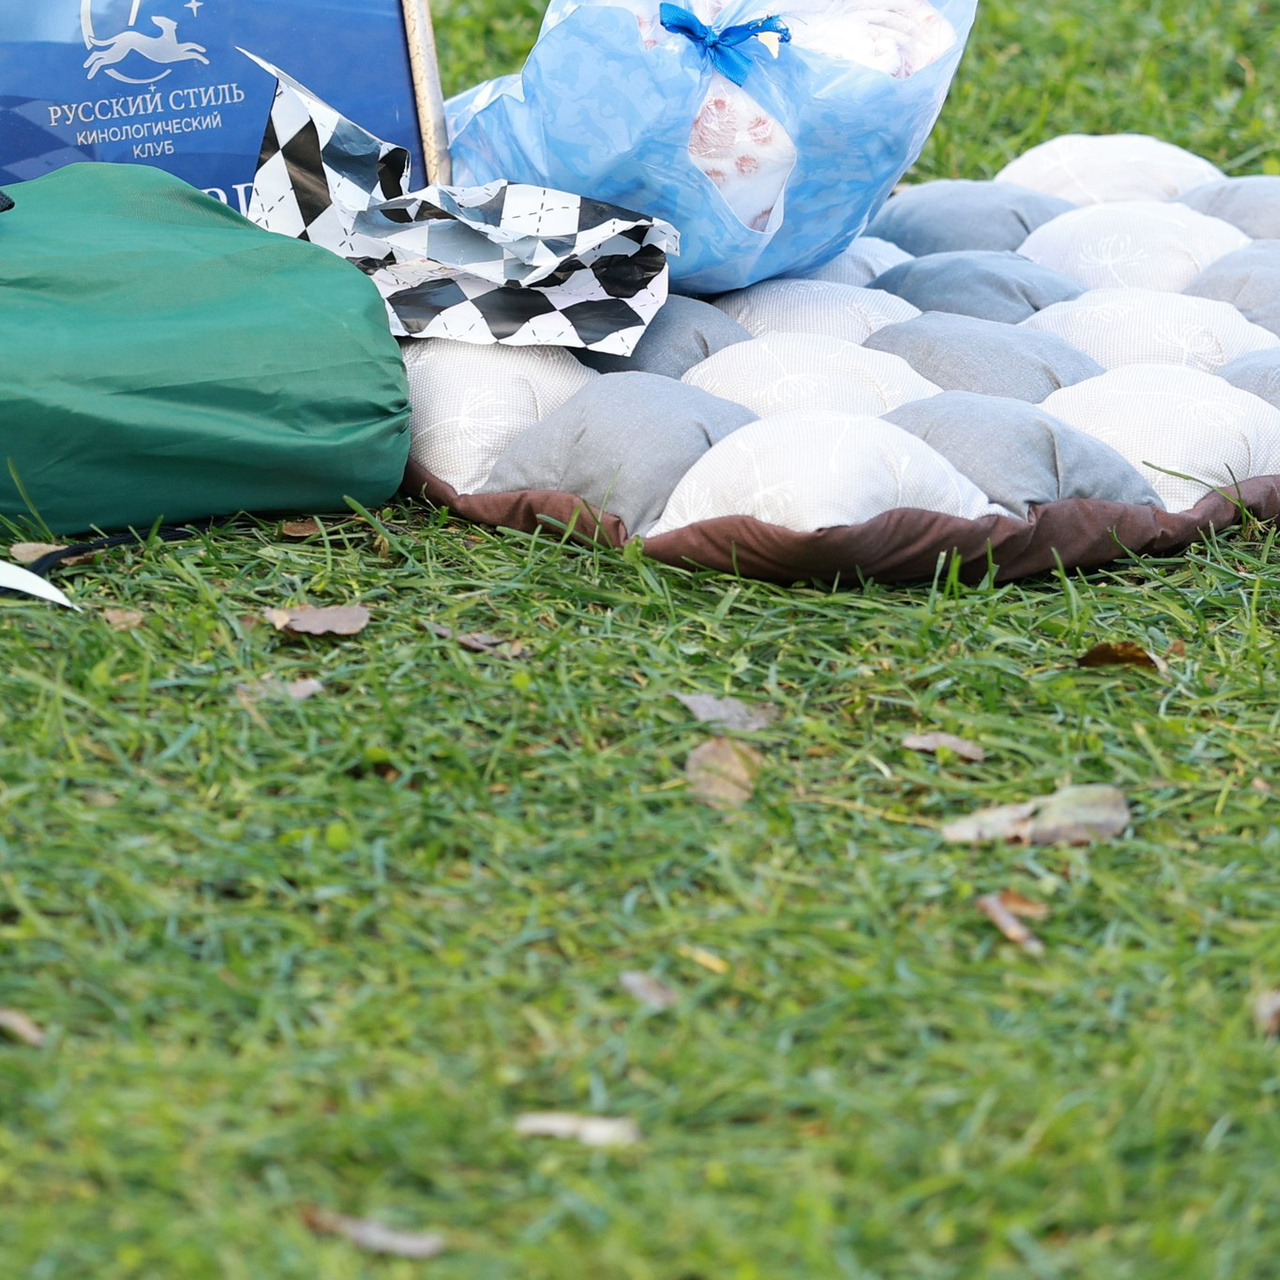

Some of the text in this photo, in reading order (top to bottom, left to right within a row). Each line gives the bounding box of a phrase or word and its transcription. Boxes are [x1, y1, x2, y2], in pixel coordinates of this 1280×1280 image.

[48, 82, 246, 126] РУССКИЙ СТИЛЬ
[76, 113, 222, 146] КИНОЛОГИЧЕСКИЙ
[132, 139, 175, 159] КЛУБ
